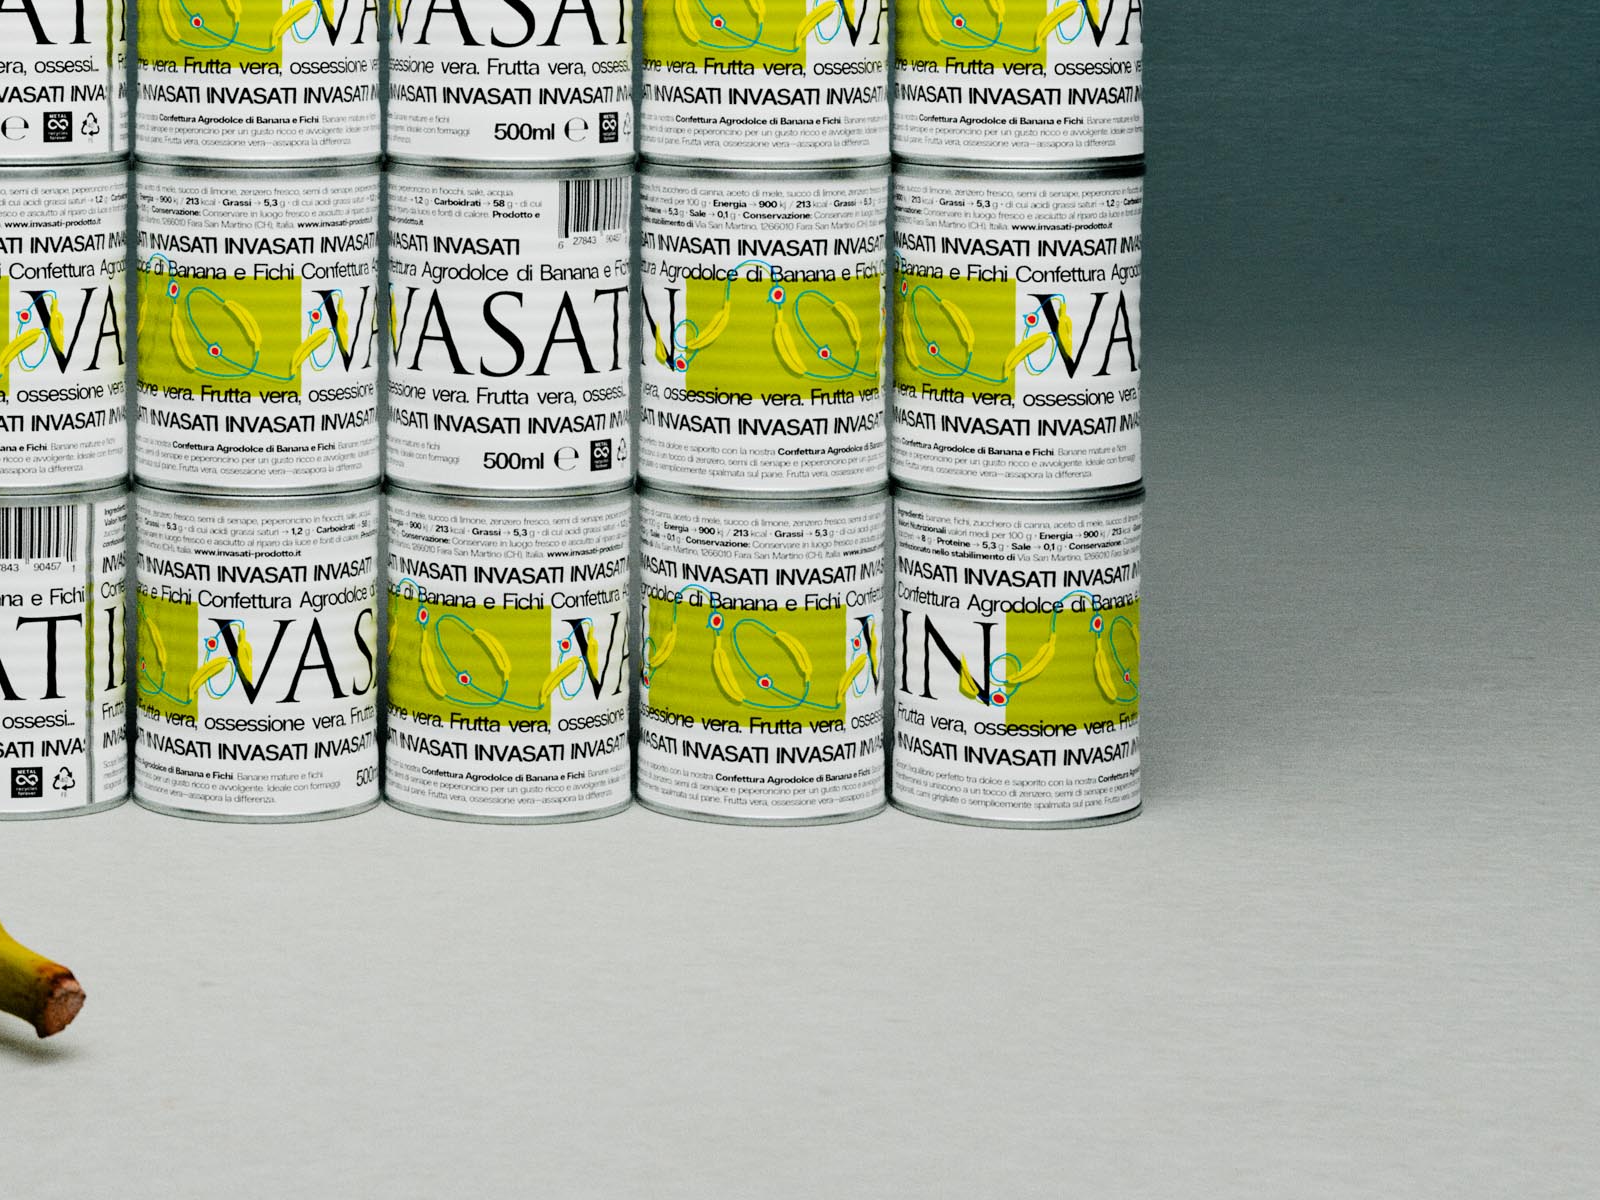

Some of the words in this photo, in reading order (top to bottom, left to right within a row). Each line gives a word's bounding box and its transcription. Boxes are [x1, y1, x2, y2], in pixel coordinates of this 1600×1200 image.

[184, 56, 231, 74] Frutta
[814, 61, 882, 75] ossessione
[495, 123, 554, 140] 500ml
[225, 237, 314, 254] INVASATI
[434, 236, 519, 255] INVASATI
[738, 239, 827, 256] INVASATI
[1038, 238, 1116, 256] INVASATI
[302, 262, 369, 279] Confettura
[661, 260, 738, 283] Agrodolce
[1016, 266, 1105, 282] Confettura
[811, 388, 854, 405] Frutta
[484, 452, 544, 469] 500ml
[218, 566, 306, 583] INVASATI
[475, 567, 563, 584] INVASATI
[776, 565, 856, 585] INVASATI
[965, 568, 1056, 587] INVASATI
[503, 593, 544, 610] Fichi
[967, 594, 1063, 617] Agrodolce
[205, 715, 305, 731] ossessione
[451, 712, 500, 732] Frutta
[974, 720, 1077, 737] ossessione
